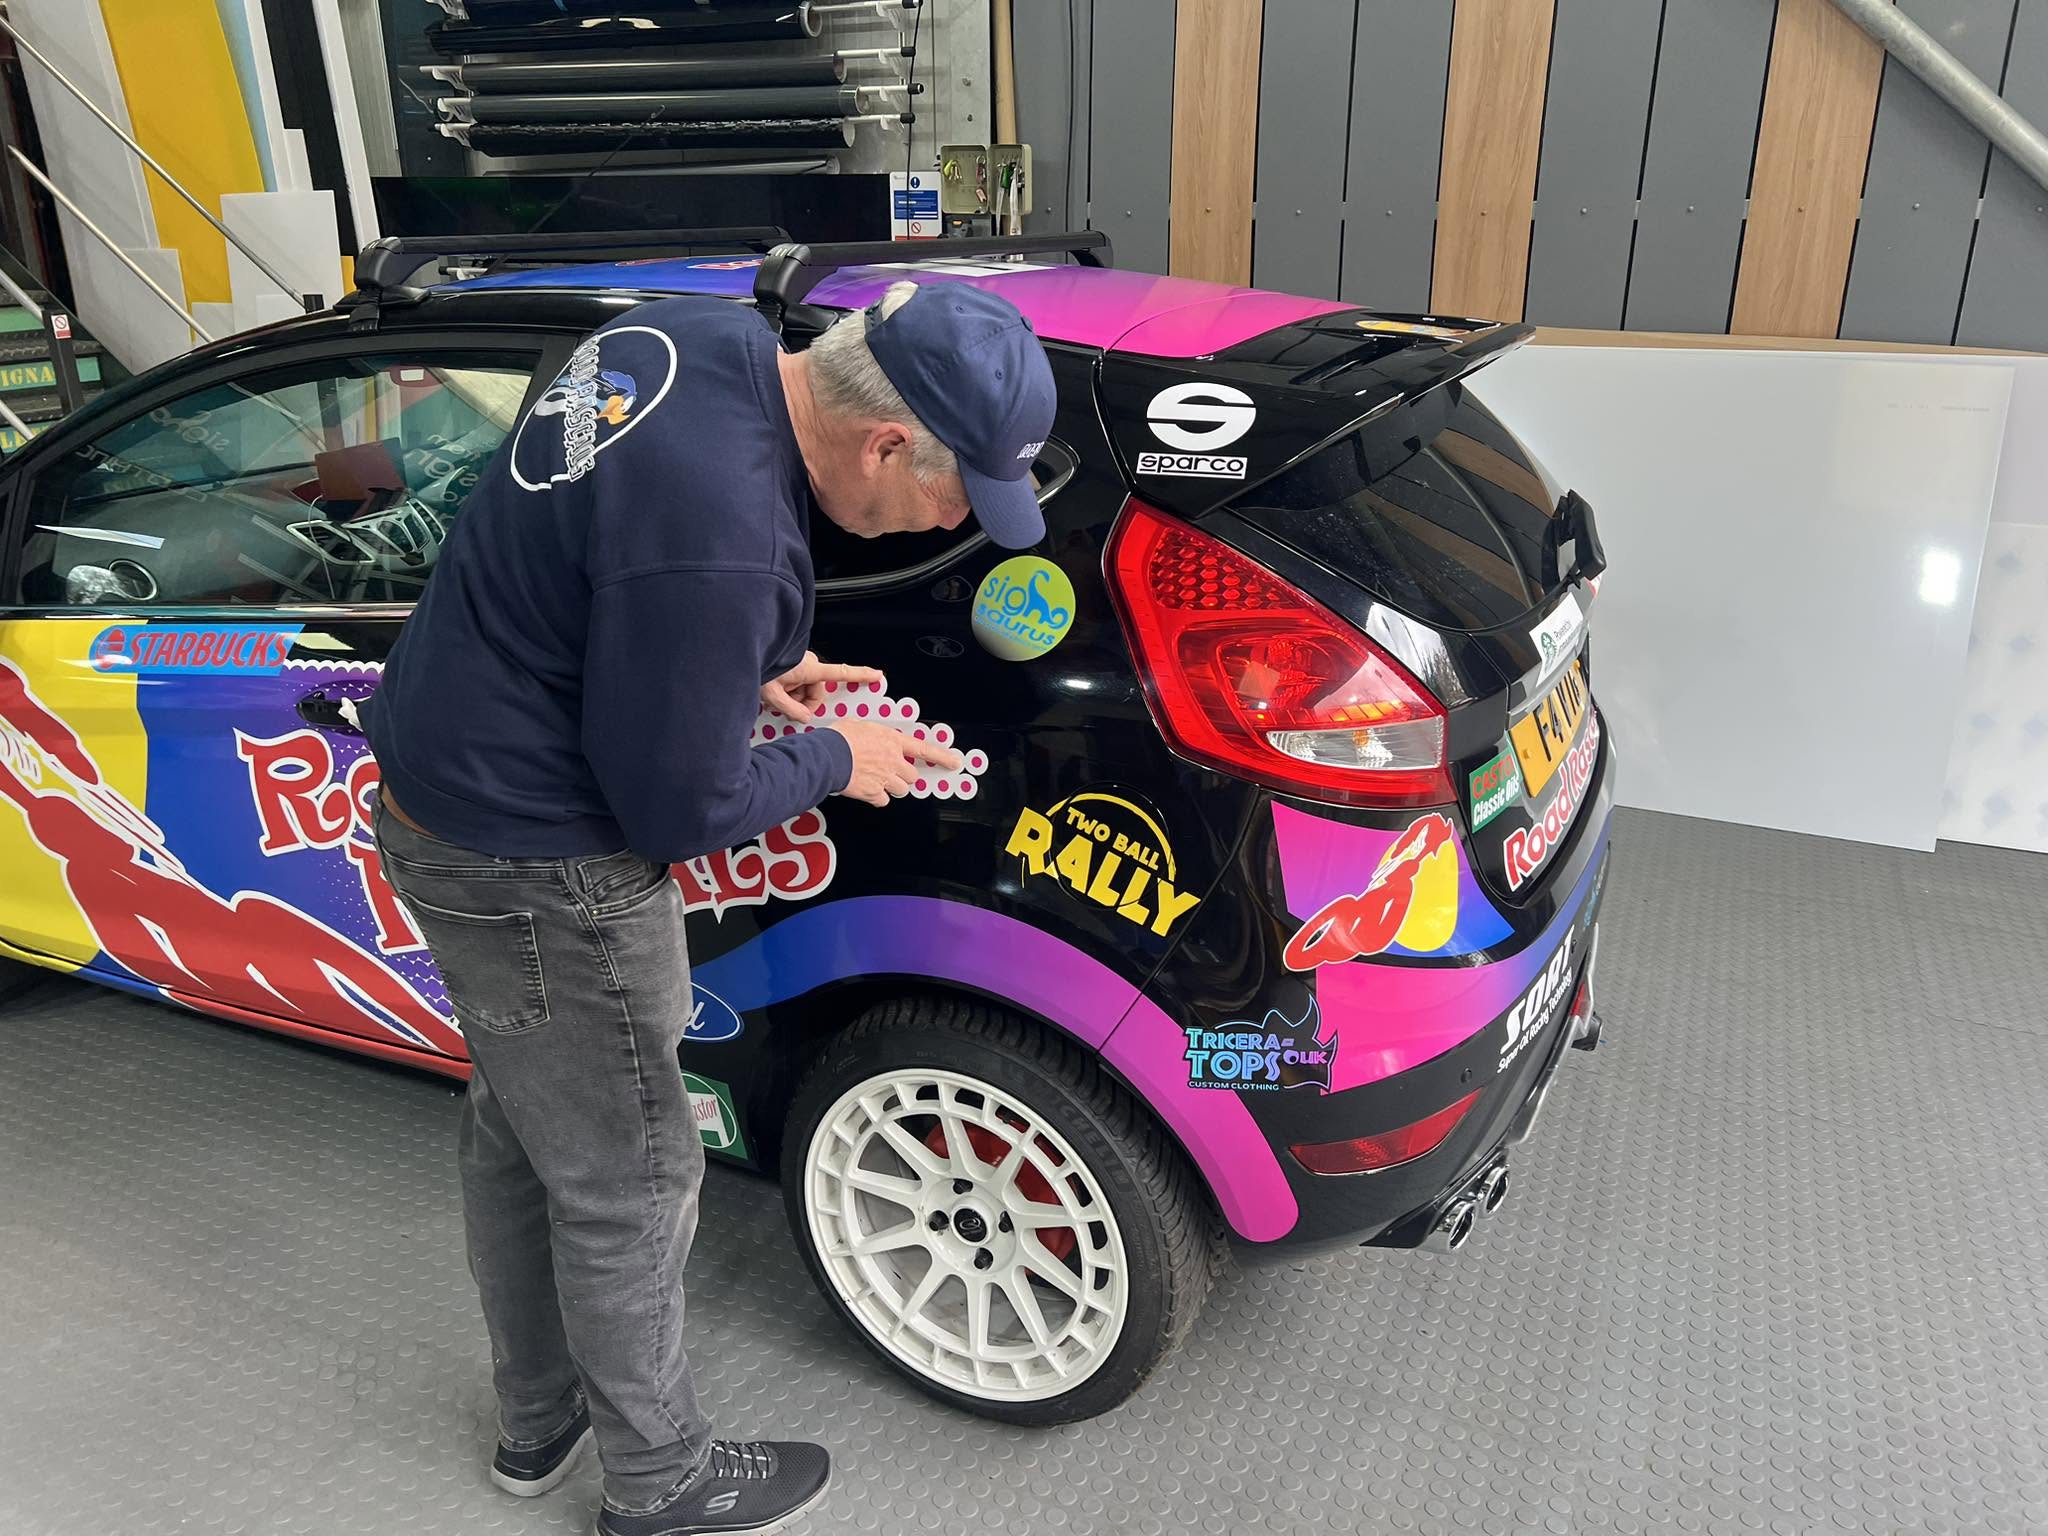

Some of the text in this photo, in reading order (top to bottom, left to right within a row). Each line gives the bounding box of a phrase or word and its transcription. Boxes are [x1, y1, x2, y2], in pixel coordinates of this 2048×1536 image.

[1140, 455, 1244, 473] sparco
[130, 630, 290, 668] STARBUCKS
[1473, 787, 1505, 826] Classic
[1066, 806, 1160, 871] TWO BALL
[1503, 766, 1574, 892] Road
[1005, 806, 1201, 937] RALLY
[1186, 1051, 1281, 1082] TOPS
[1188, 1081, 1279, 1091] CUSTOM CLOTHING
